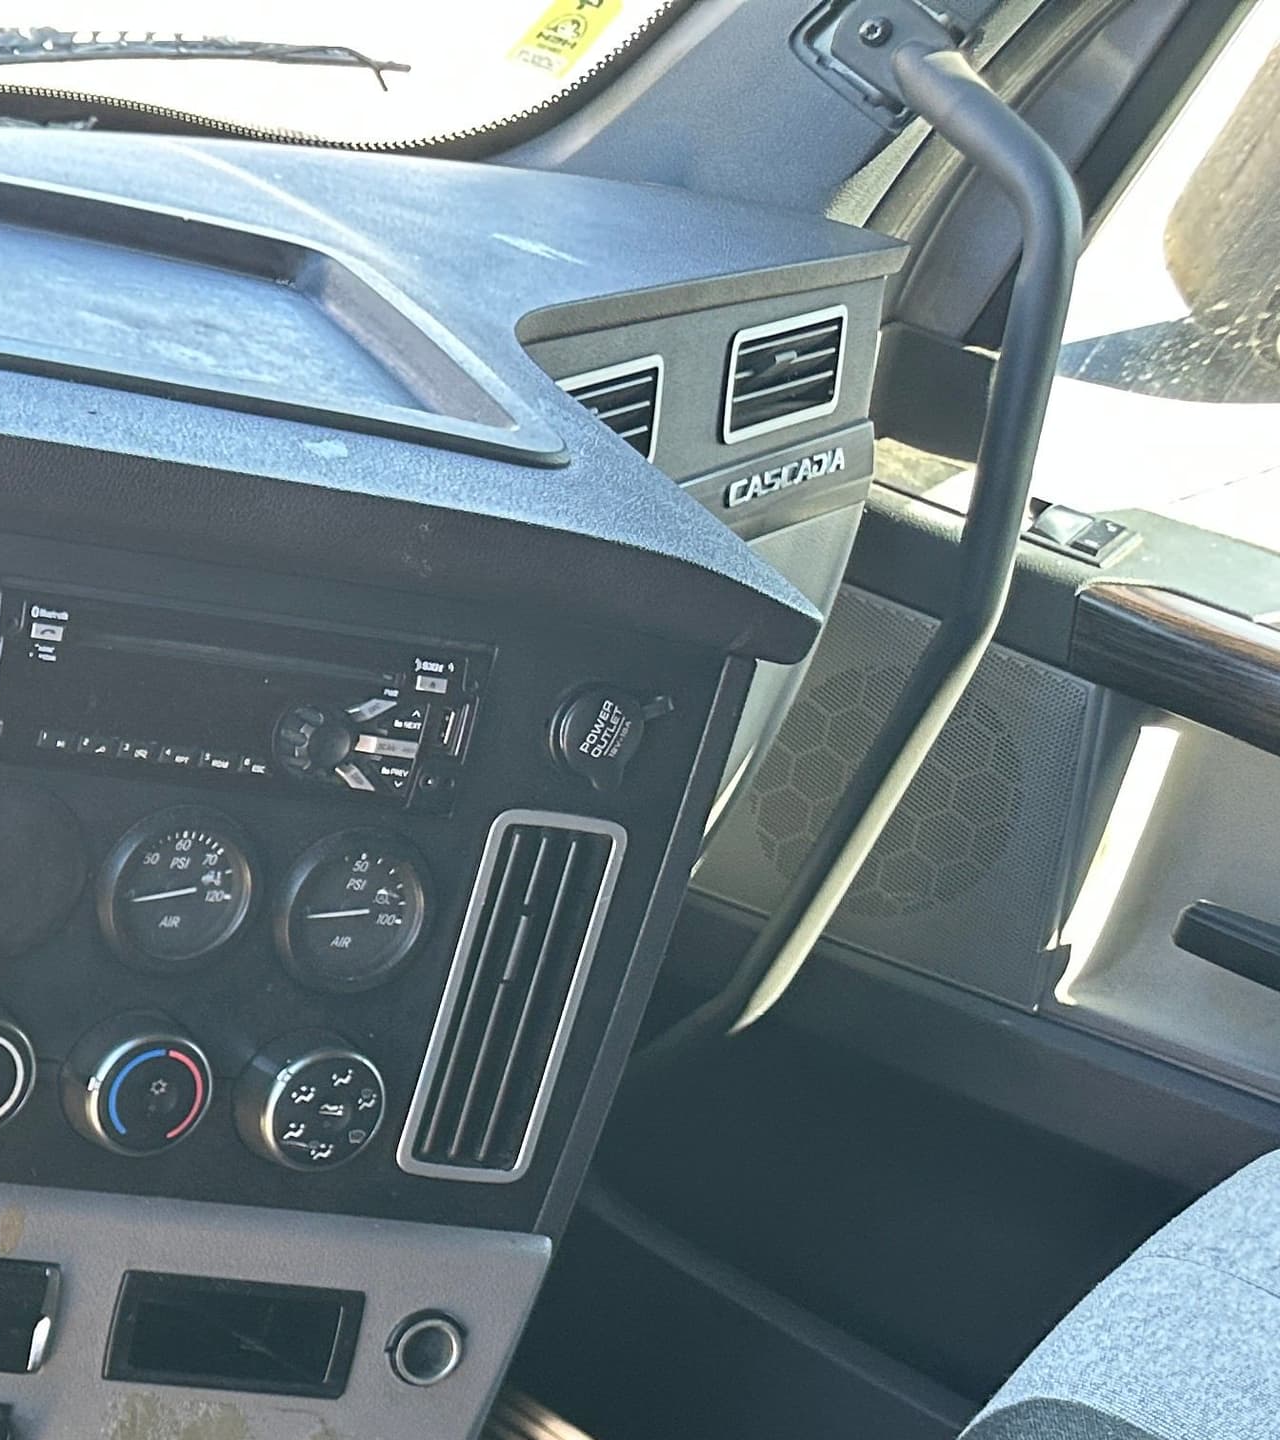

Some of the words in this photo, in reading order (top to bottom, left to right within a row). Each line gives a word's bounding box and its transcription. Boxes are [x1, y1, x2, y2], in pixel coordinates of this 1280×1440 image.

[726, 447, 846, 508] CASCADIA
[579, 699, 614, 754] POWER
[591, 705, 623, 758] OUTLET
[175, 838, 192, 851] 60
[143, 852, 160, 865] 50
[170, 857, 191, 869] PSI
[202, 854, 218, 866] 70
[352, 860, 369, 872] 50
[346, 878, 367, 891] PSI
[159, 916, 181, 929] AIR
[376, 914, 396, 926] 100
[330, 936, 352, 949] AIR
